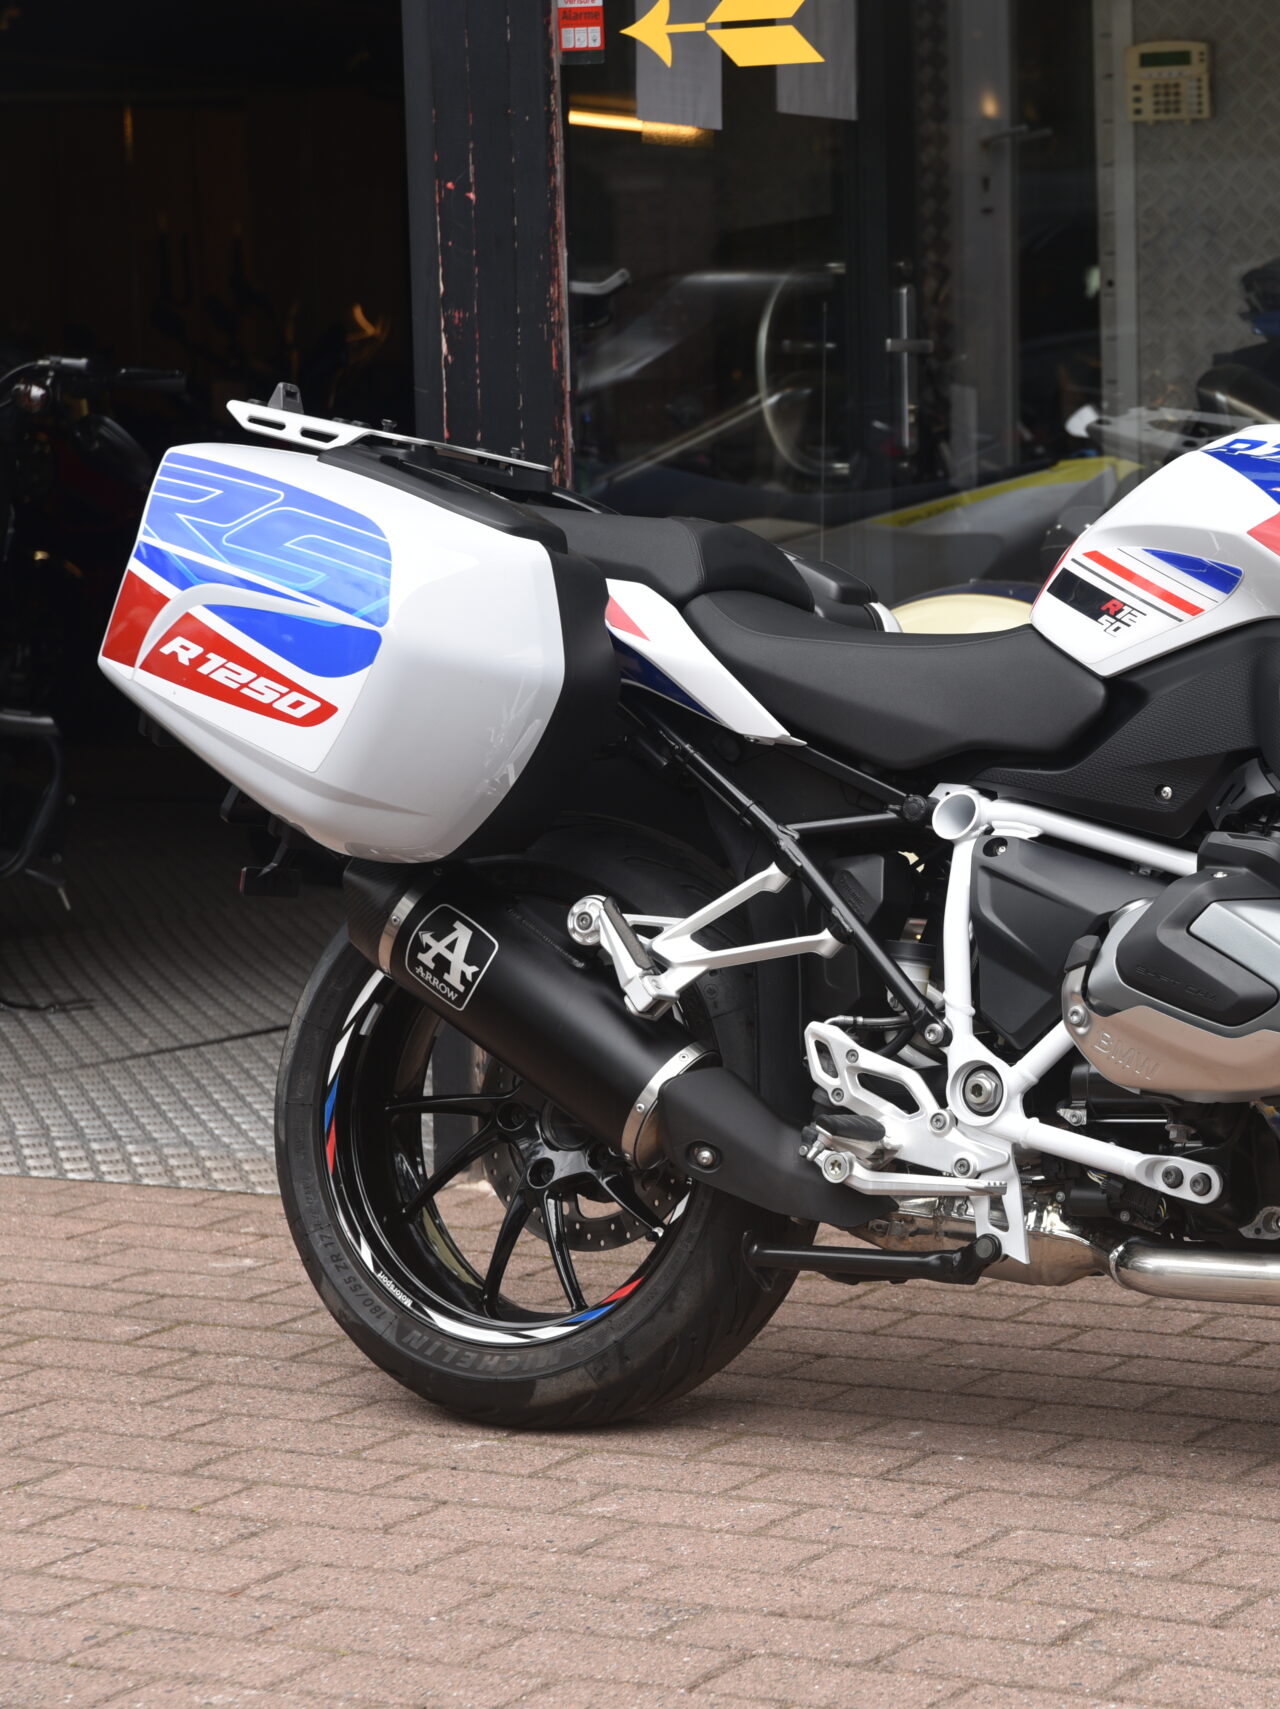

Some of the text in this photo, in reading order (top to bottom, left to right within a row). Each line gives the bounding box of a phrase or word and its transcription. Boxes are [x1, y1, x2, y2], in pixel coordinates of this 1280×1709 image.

[562, 9, 600, 20] Alarme
[415, 965, 458, 1000] ARROW
[1094, 1032, 1160, 1080] BMW
[319, 1232, 386, 1320] 180/55 ZR 17
[377, 1271, 414, 1308] Motorsport
[402, 1330, 562, 1373] MICHELIN
